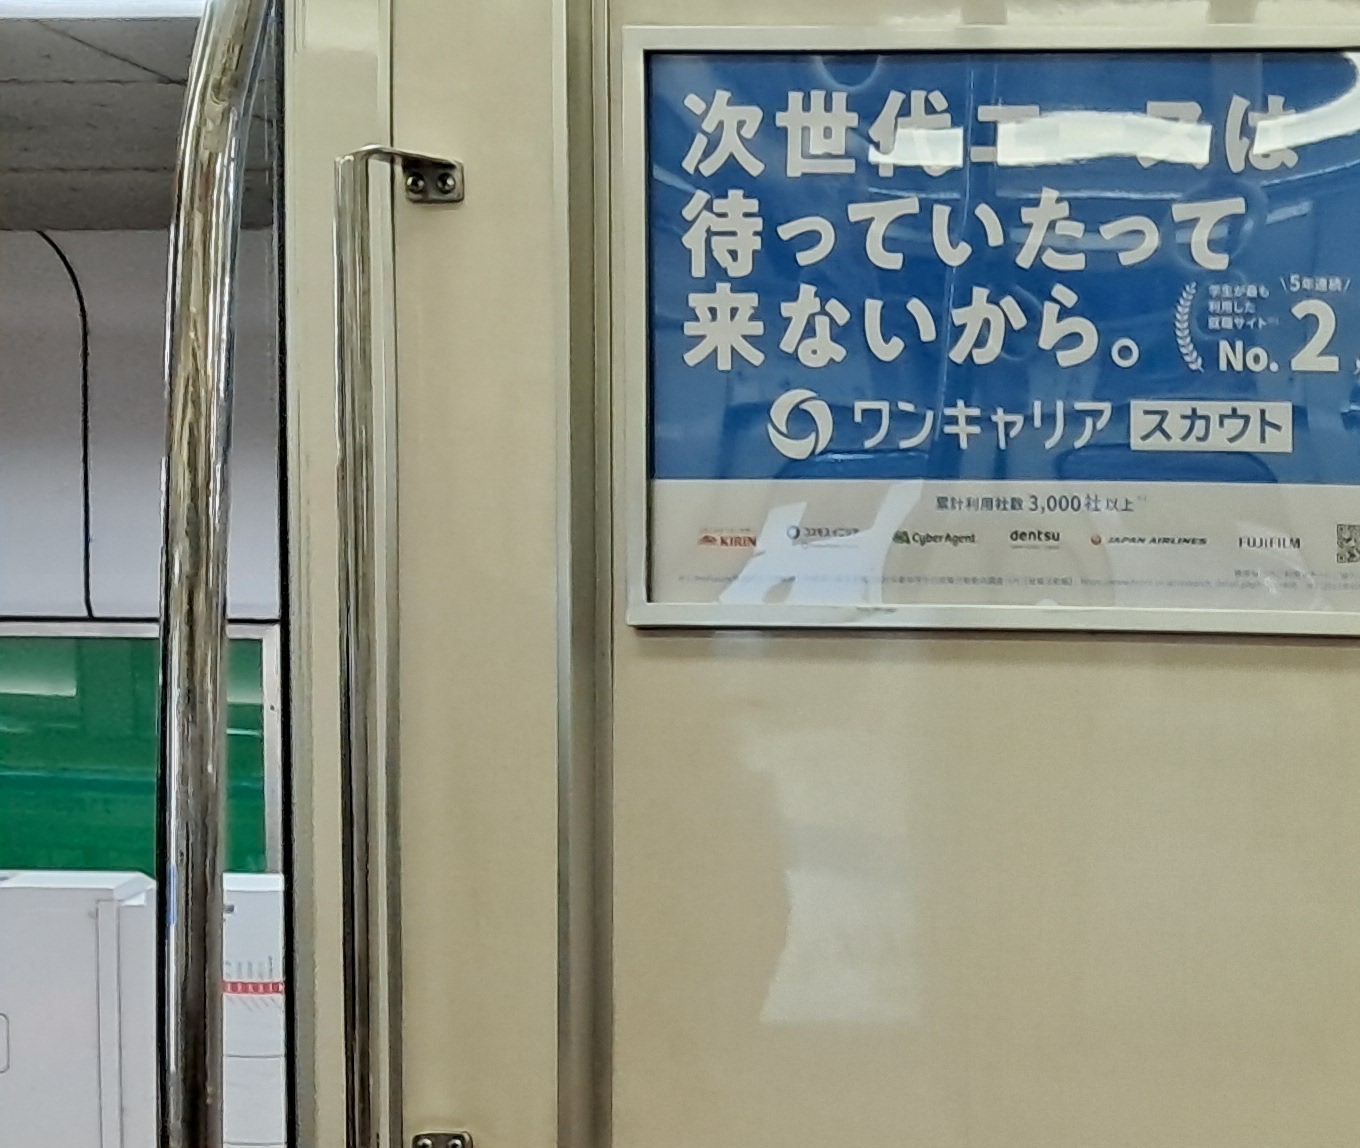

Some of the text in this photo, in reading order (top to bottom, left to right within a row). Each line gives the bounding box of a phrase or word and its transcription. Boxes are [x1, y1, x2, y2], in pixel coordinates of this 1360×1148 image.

[681, 187, 1247, 278] 待っていたって
[1209, 284, 1269, 299] 学生が最も
[1208, 301, 1256, 314] 利用した
[683, 283, 1139, 371] 来ないから。
[1218, 299, 1340, 372] No. 2
[853, 399, 1285, 450] ワンキャリア スカウト
[720, 536, 757, 547] KIRIN
[1010, 529, 1061, 542] dentsu
[1239, 537, 1301, 549] FUJIFILM
